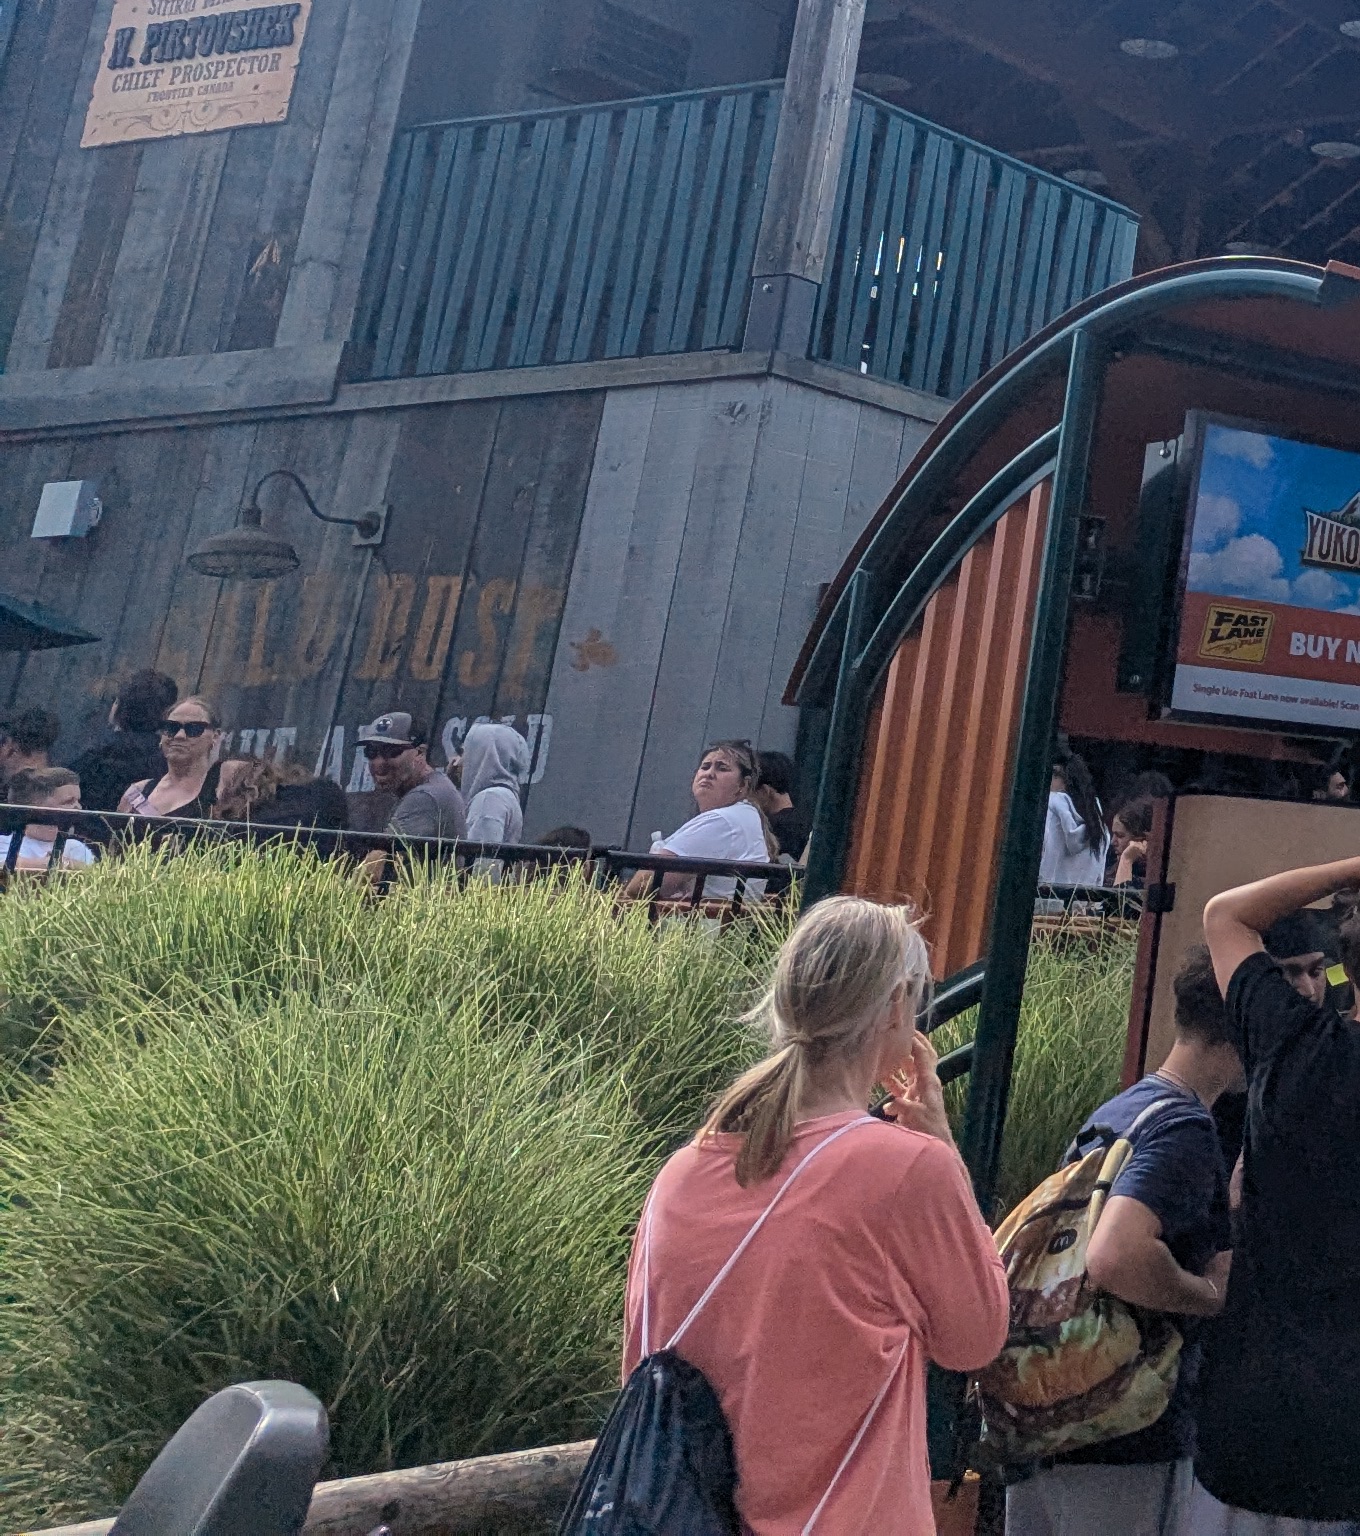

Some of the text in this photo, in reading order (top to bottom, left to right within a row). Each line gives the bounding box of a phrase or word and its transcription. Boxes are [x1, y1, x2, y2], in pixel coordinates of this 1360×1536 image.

[111, 52, 282, 94] CHIEF PROSPECTOR
[197, 81, 234, 97] CANADA
[1213, 610, 1268, 627] FAST
[1207, 627, 1265, 644] LANE
[1289, 631, 1342, 661] BUY
[1193, 683, 1221, 696] Single
[1222, 686, 1239, 697] Use
[1240, 688, 1258, 700] Fast
[1259, 689, 1279, 702] Lane
[1280, 695, 1299, 704] now
